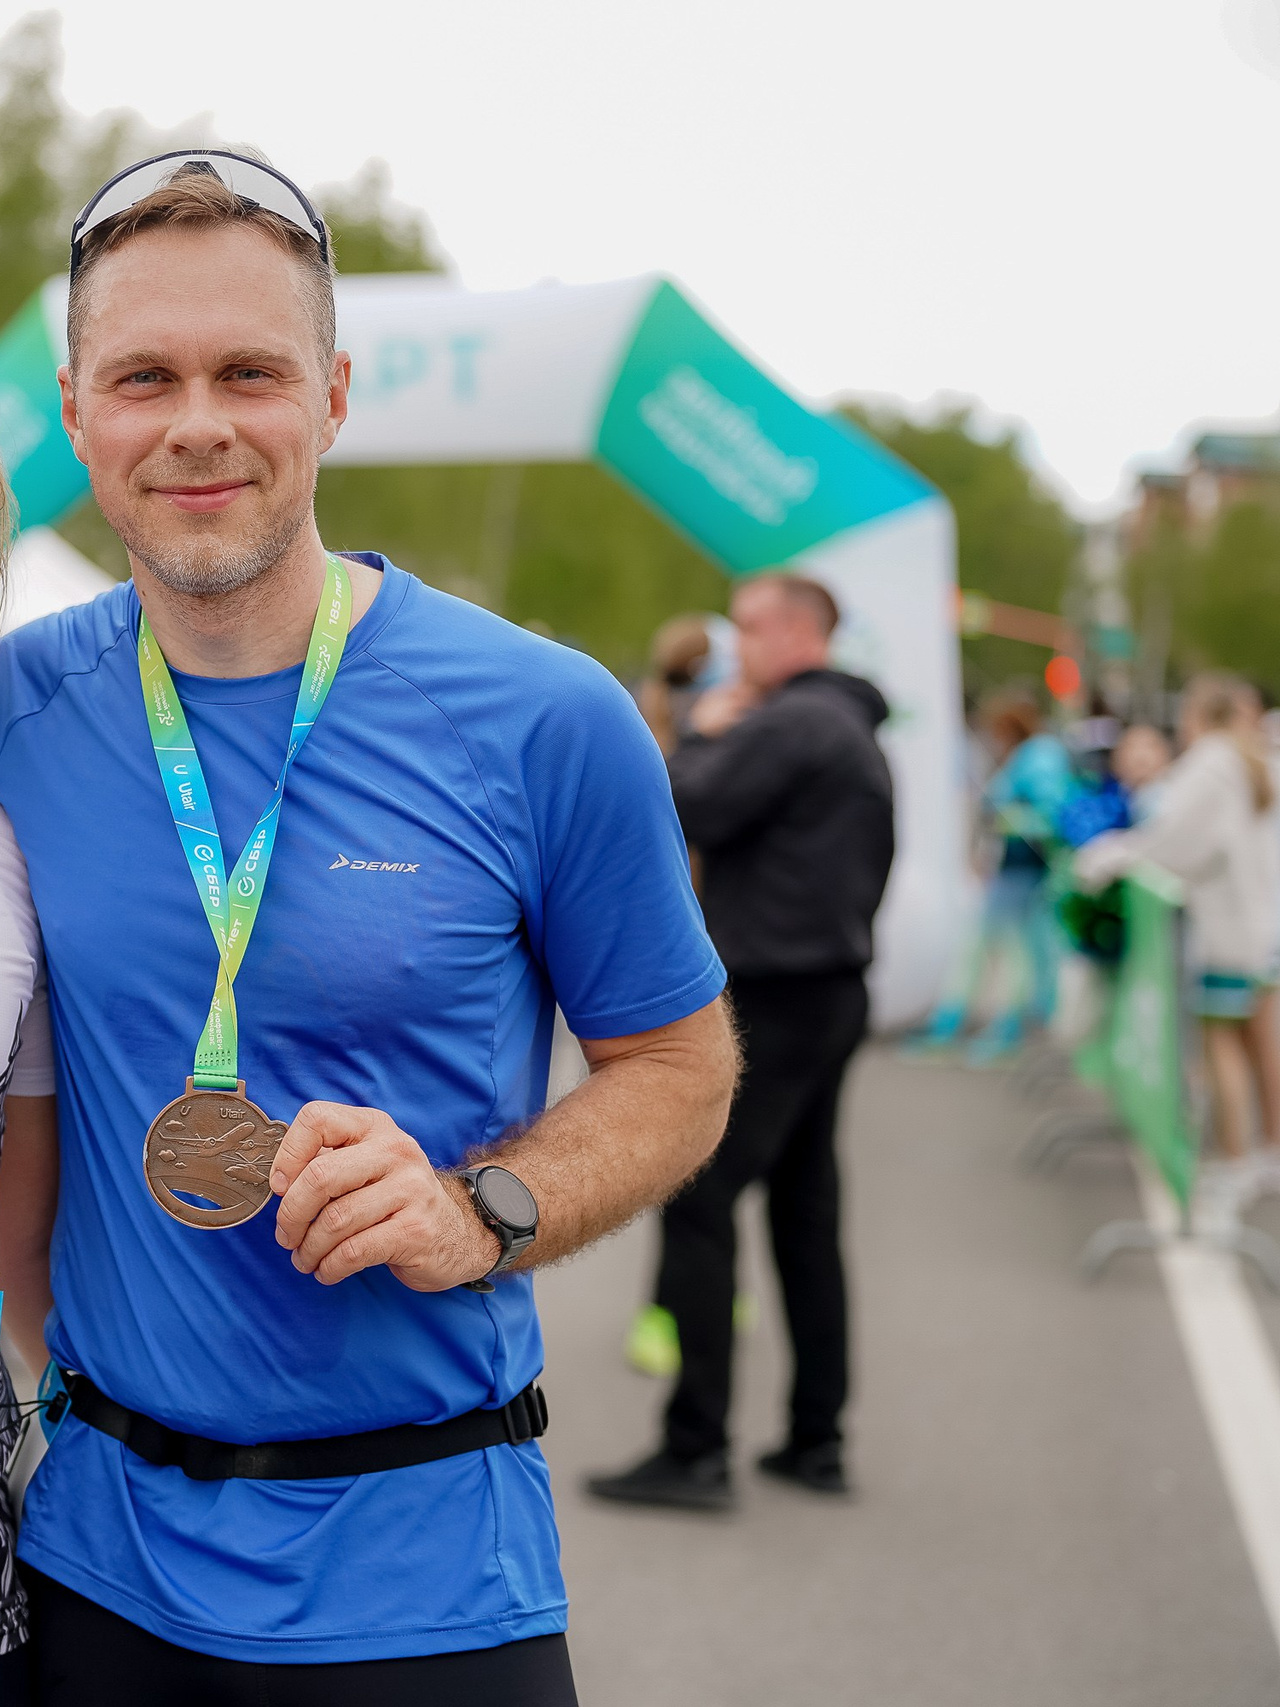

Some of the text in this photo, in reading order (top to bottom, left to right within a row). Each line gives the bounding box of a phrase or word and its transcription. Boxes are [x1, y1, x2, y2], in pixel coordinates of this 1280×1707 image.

[329, 575, 343, 625] 185 лет
[309, 660, 322, 694] зелёный
[312, 666, 327, 702] марафон
[178, 782, 195, 811] Utair
[245, 829, 266, 872] СБЕР
[349, 860, 420, 873] DEMIX
[203, 865, 220, 908] СБЕР
[227, 918, 243, 948] лет
[214, 1012, 223, 1050] марафон
[220, 1108, 246, 1119] Utair
